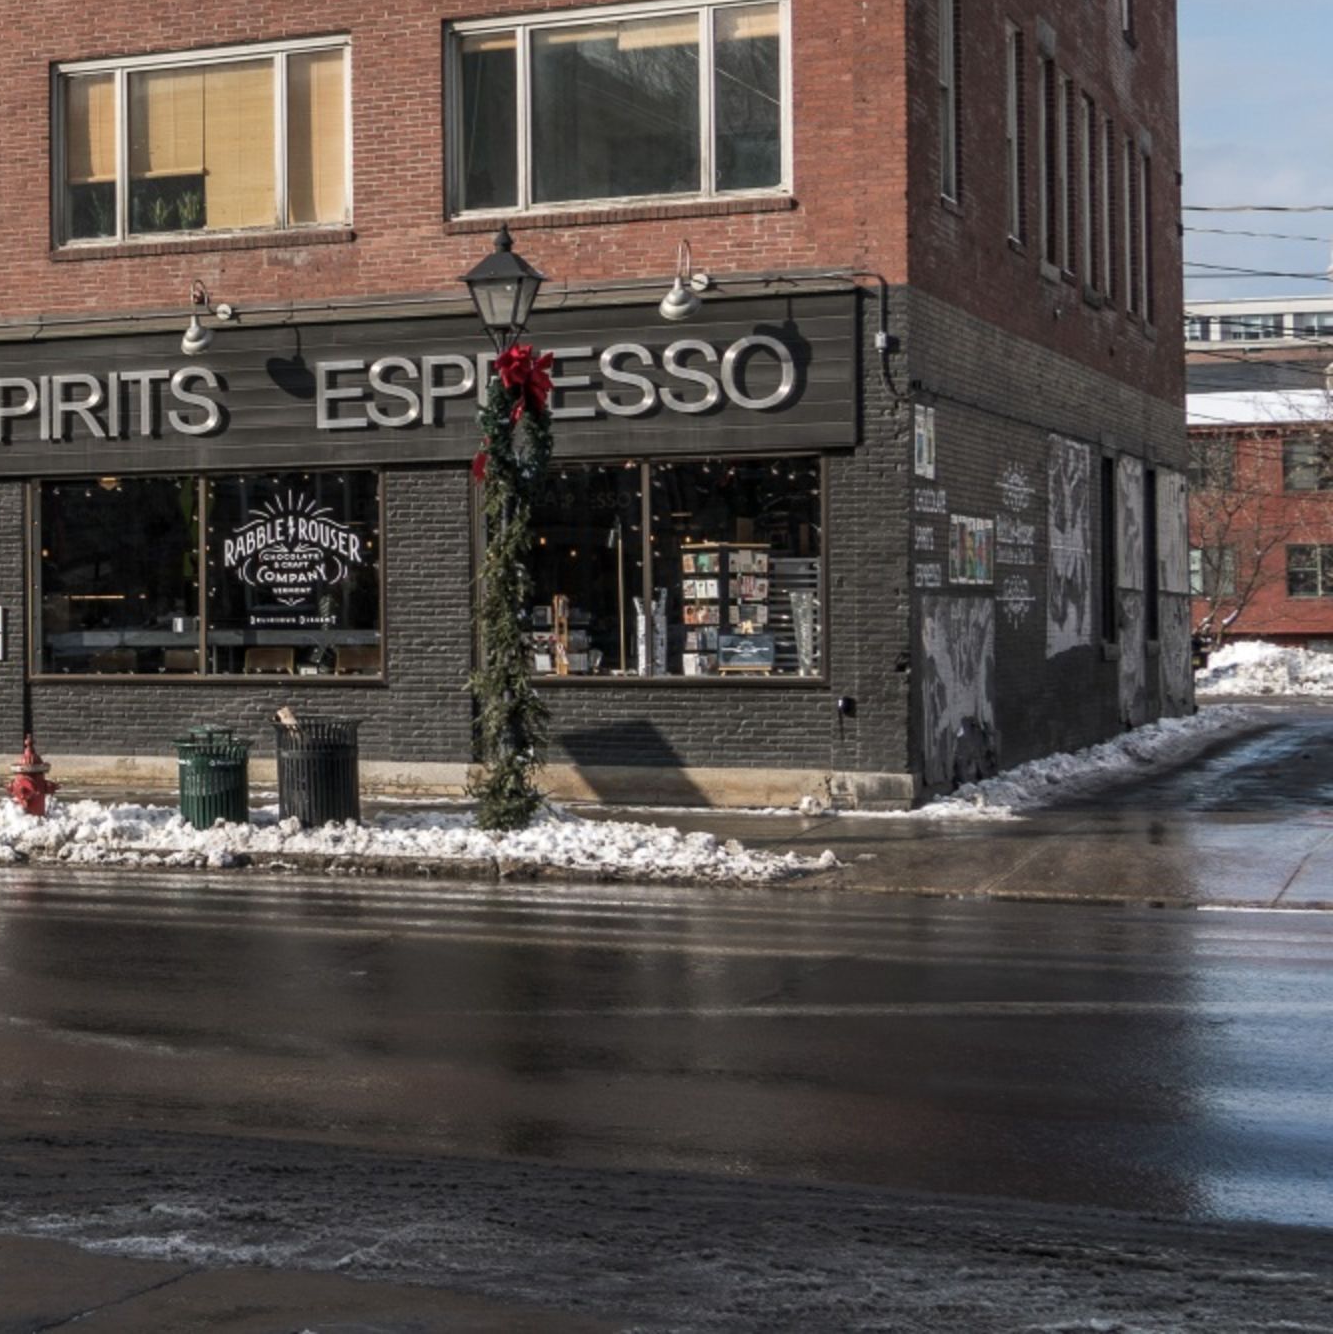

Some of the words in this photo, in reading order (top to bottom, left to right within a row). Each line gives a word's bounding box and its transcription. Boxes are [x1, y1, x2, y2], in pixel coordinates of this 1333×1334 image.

[224, 518, 285, 567] RABBLE
[298, 517, 362, 563] ROUSER
[263, 553, 319, 561] CHOCOLATE
[280, 561, 309, 569] CRAFT
[257, 564, 328, 583] COMPANY
